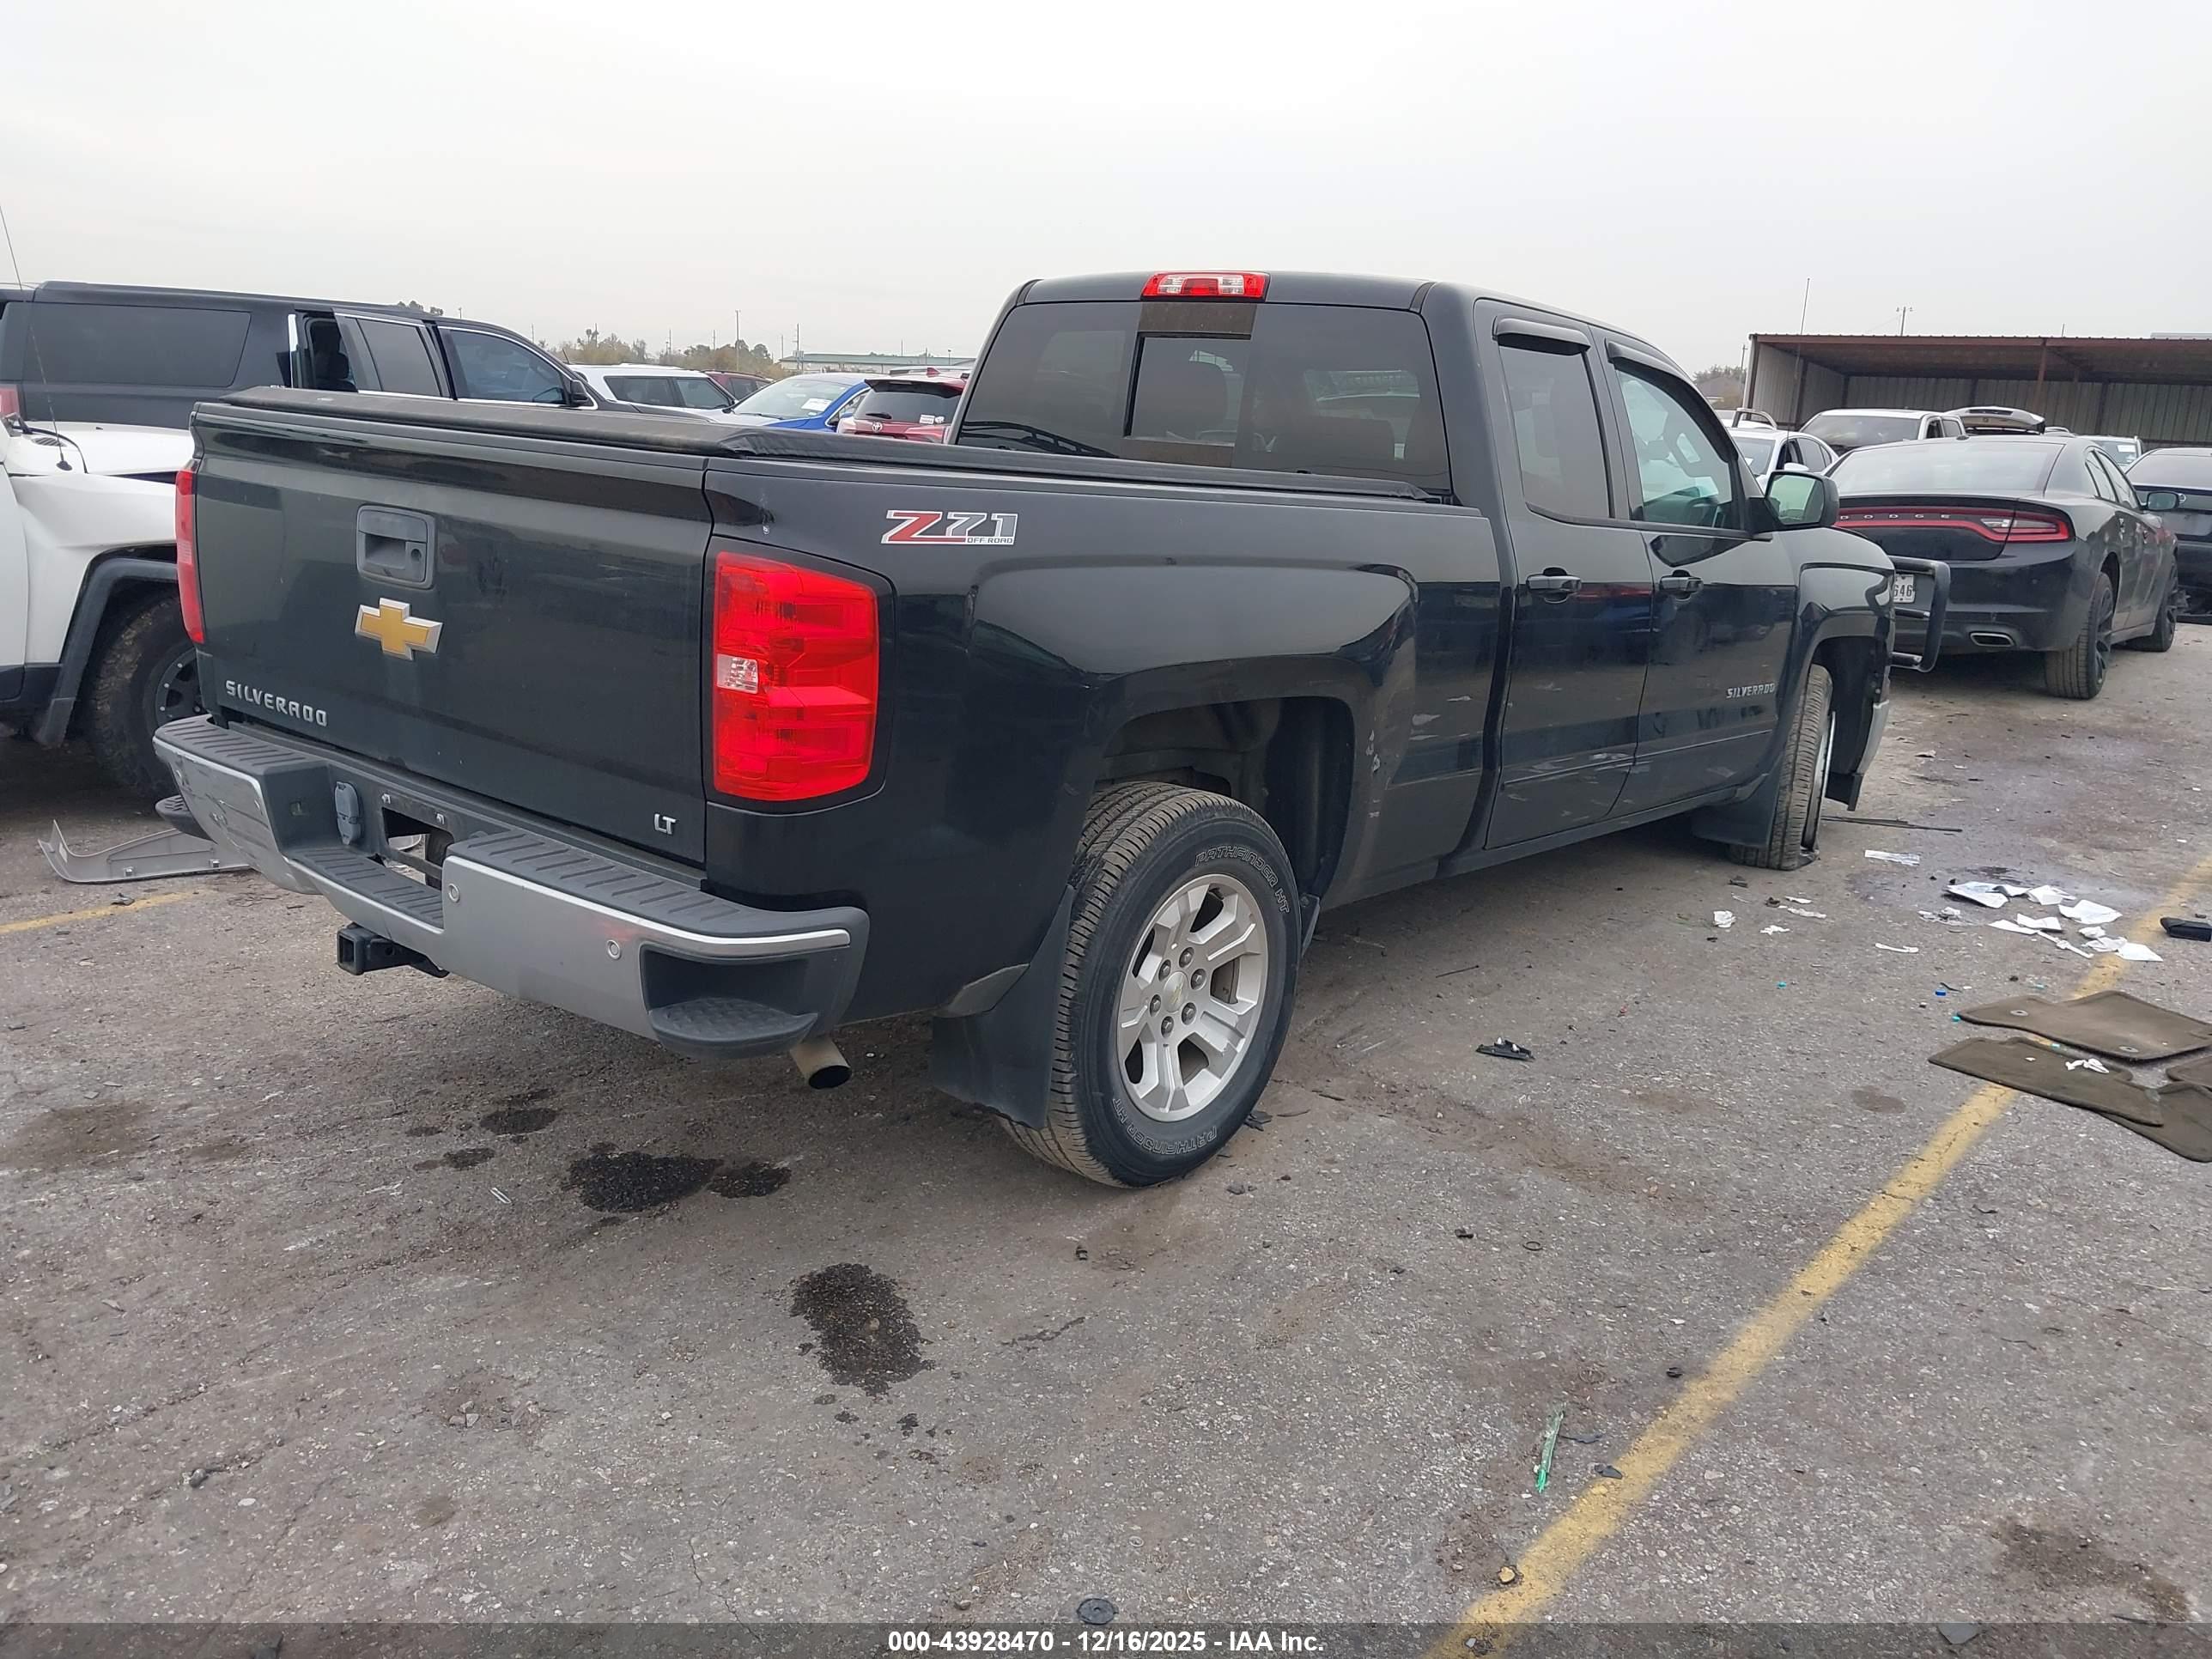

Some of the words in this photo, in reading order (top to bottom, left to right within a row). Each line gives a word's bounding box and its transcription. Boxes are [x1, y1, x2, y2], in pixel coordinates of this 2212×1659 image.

[881, 510, 1018, 544] Z71
[226, 680, 327, 726] SILVERADO
[1726, 683, 1776, 699] SILVERADO
[654, 813, 677, 835] LT
[1194, 845, 1279, 888] PATHFINDER
[1274, 888, 1290, 913] HT
[1112, 1098, 1127, 1124] HT
[1127, 1123, 1218, 1155] PATHFINDER
